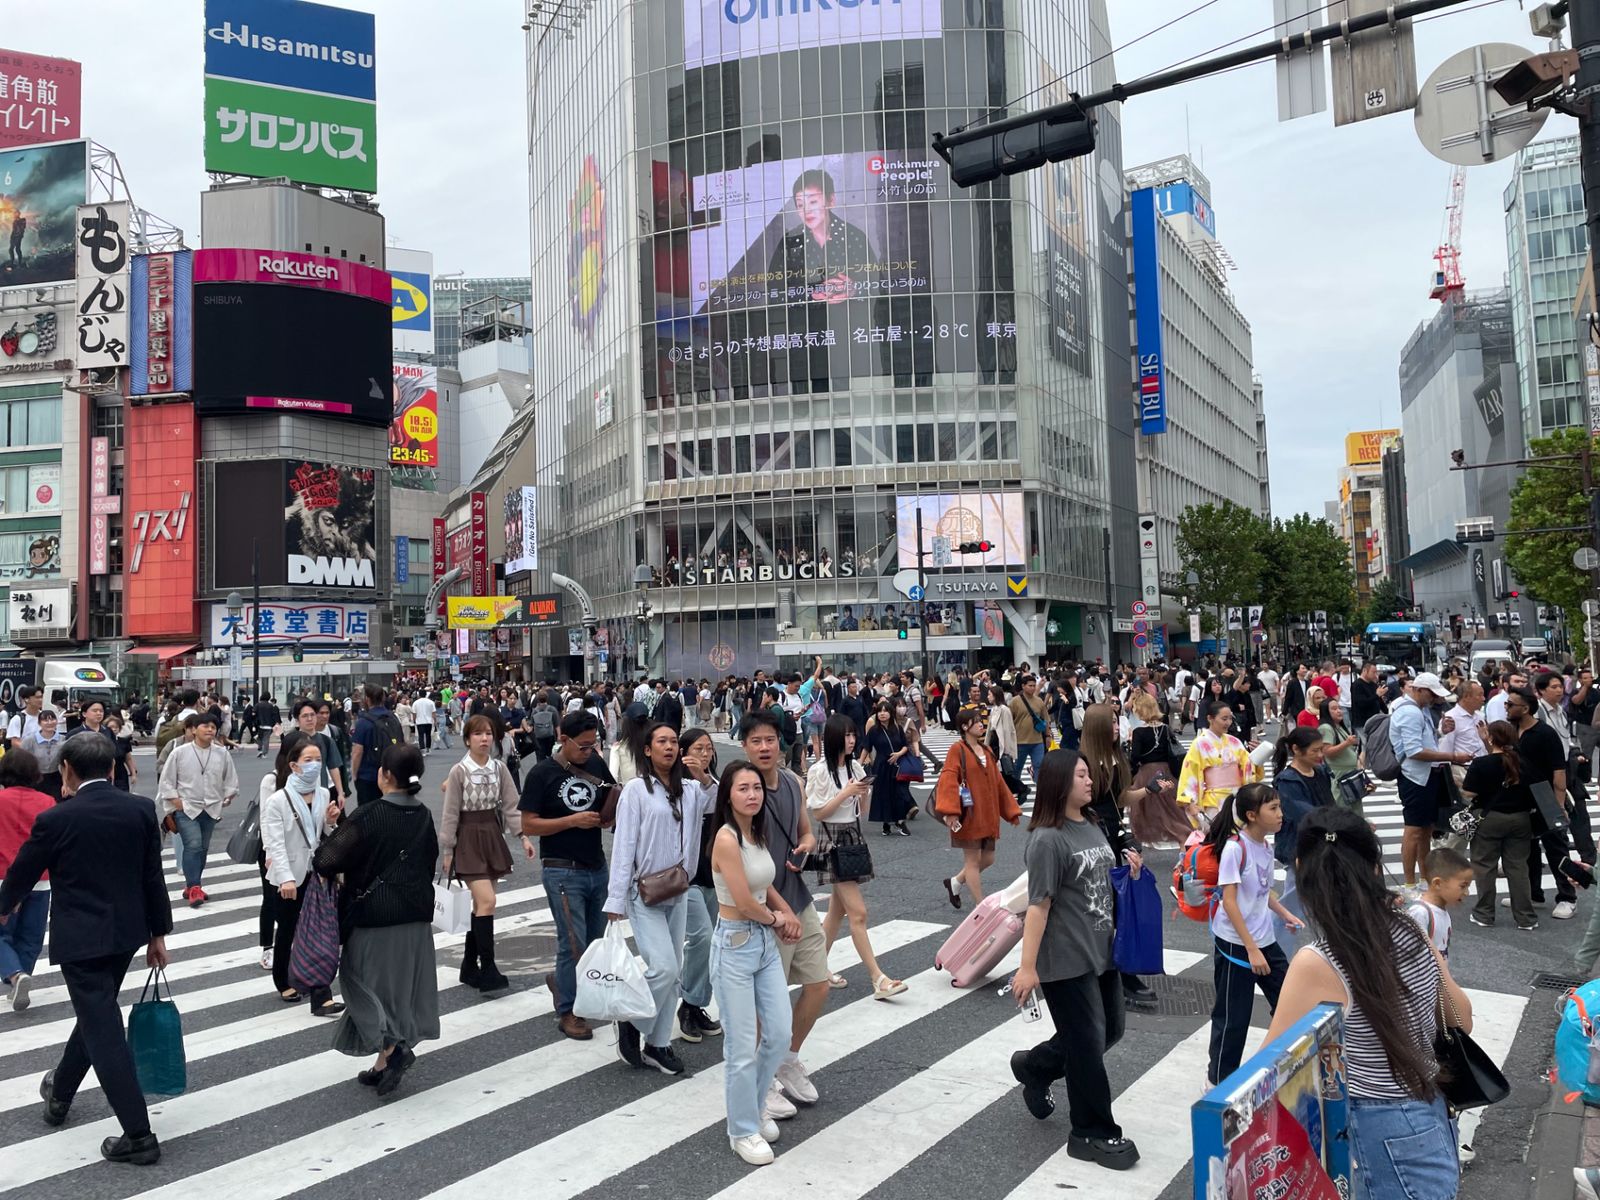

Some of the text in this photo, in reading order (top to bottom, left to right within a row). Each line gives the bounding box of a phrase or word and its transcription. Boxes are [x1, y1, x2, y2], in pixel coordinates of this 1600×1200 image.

[208, 21, 373, 69] Hisamitsu
[216, 106, 367, 164] サロンパス
[871, 159, 940, 172] Bunkamura
[881, 168, 933, 183] People!
[259, 255, 338, 281] Rakuten
[79, 205, 126, 362] もんじゃ
[203, 296, 243, 304] SHIBUYA
[985, 321, 1016, 339] 東京
[1140, 353, 1161, 422] SEIBU
[278, 399, 324, 409] Rakuten Vision
[130, 491, 192, 573] クスリ
[472, 500, 485, 555] カラオケ
[288, 553, 375, 587] DMM
[685, 560, 854, 586] STARBUCKS
[1475, 554, 1484, 582] ZARA
[936, 582, 999, 593] TSUTAYA
[529, 600, 557, 615] ALVARK
[220, 608, 368, 638] 大盛堂書店
